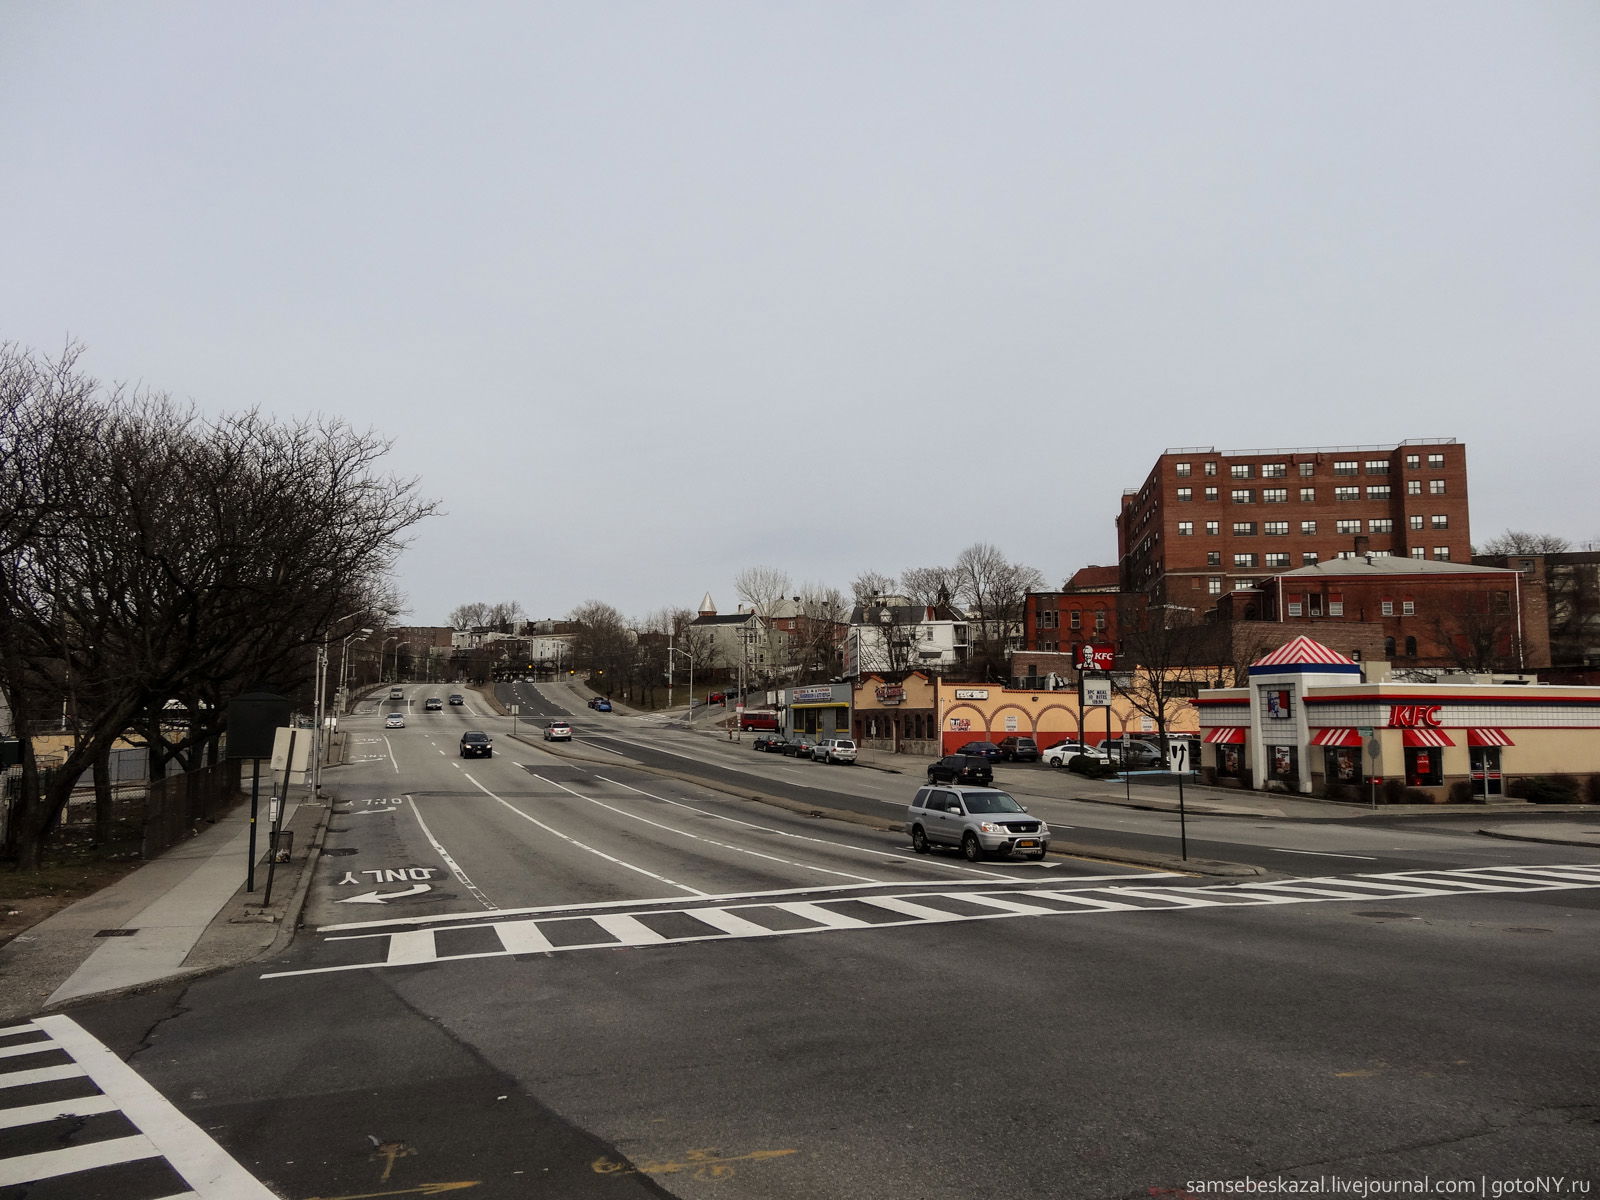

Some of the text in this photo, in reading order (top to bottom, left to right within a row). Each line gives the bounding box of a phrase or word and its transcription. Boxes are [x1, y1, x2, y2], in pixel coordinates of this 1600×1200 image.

[1094, 652, 1114, 660] KFC
[1388, 705, 1442, 727] KFC
[345, 798, 402, 806] ONLY
[338, 867, 434, 885] ONLY
